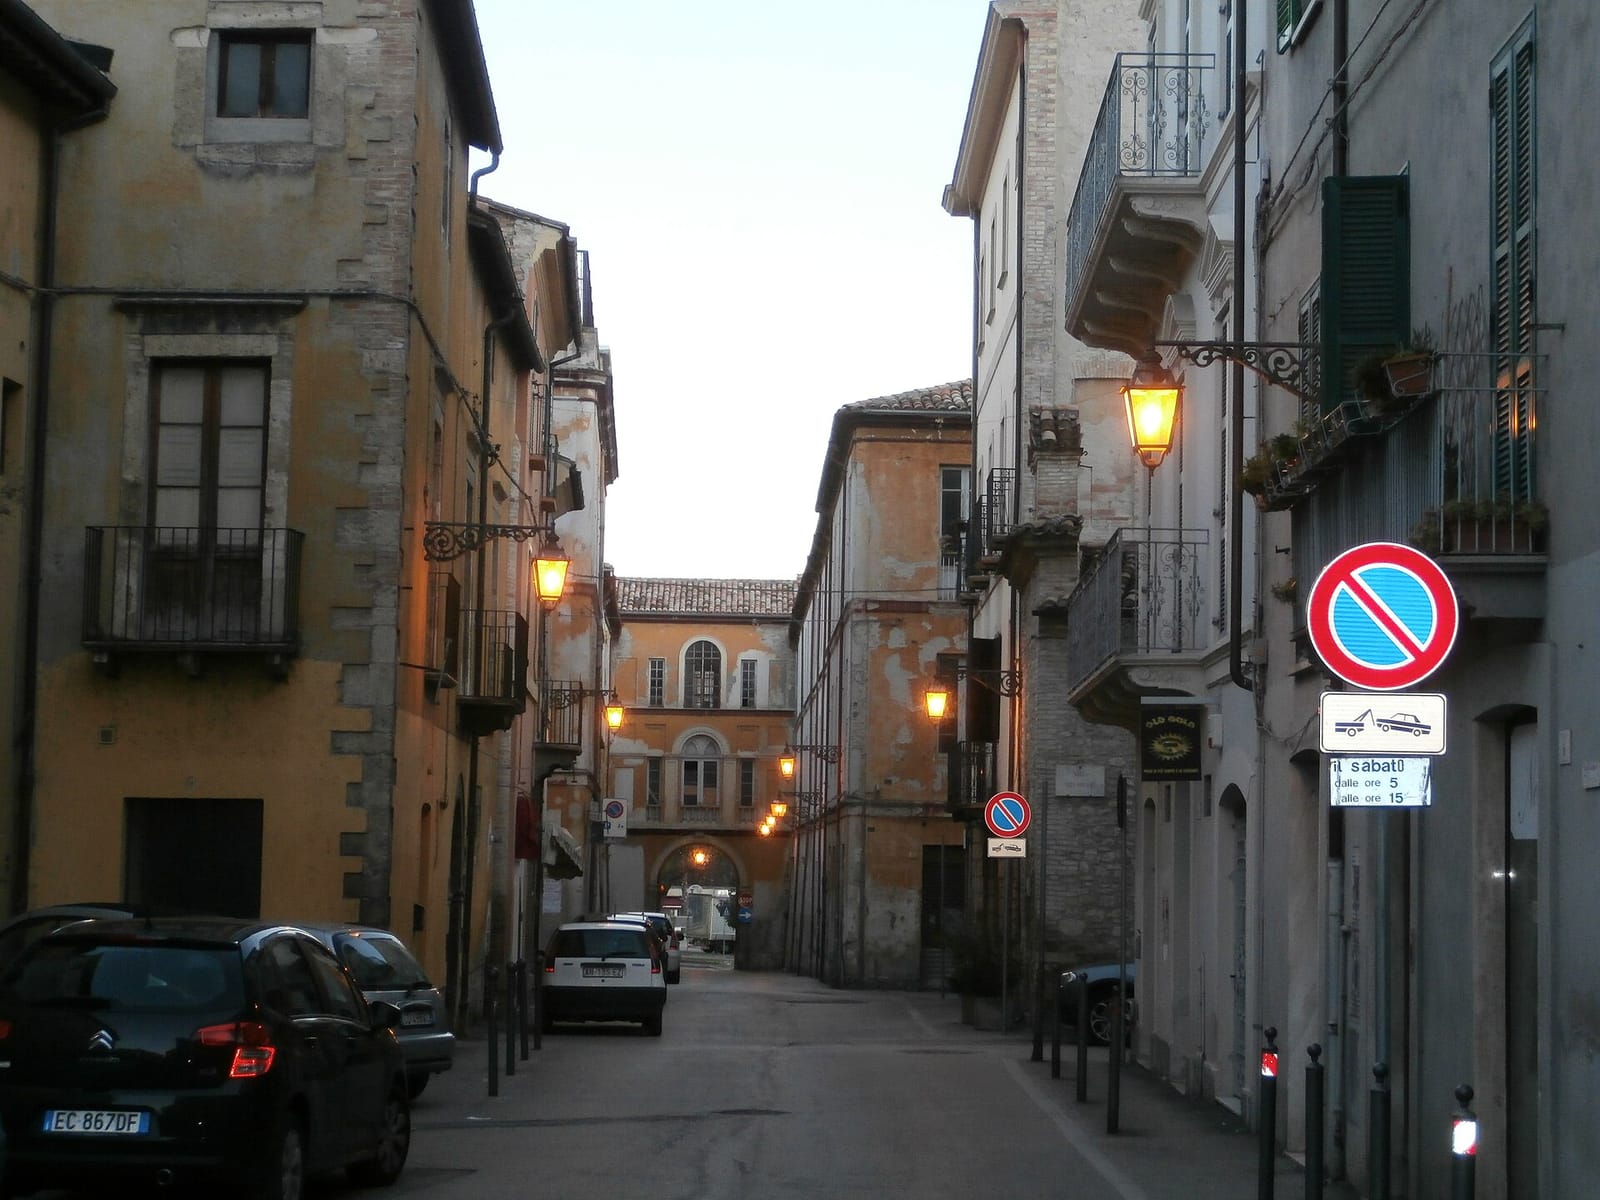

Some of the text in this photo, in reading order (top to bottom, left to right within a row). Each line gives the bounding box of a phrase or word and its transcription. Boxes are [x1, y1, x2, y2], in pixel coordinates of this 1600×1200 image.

[1333, 759, 1342, 773] il
[1334, 777, 1399, 789] dalle ore 5
[1341, 792, 1404, 804] alle ore 15
[54, 1111, 138, 1132] EC 867DF
